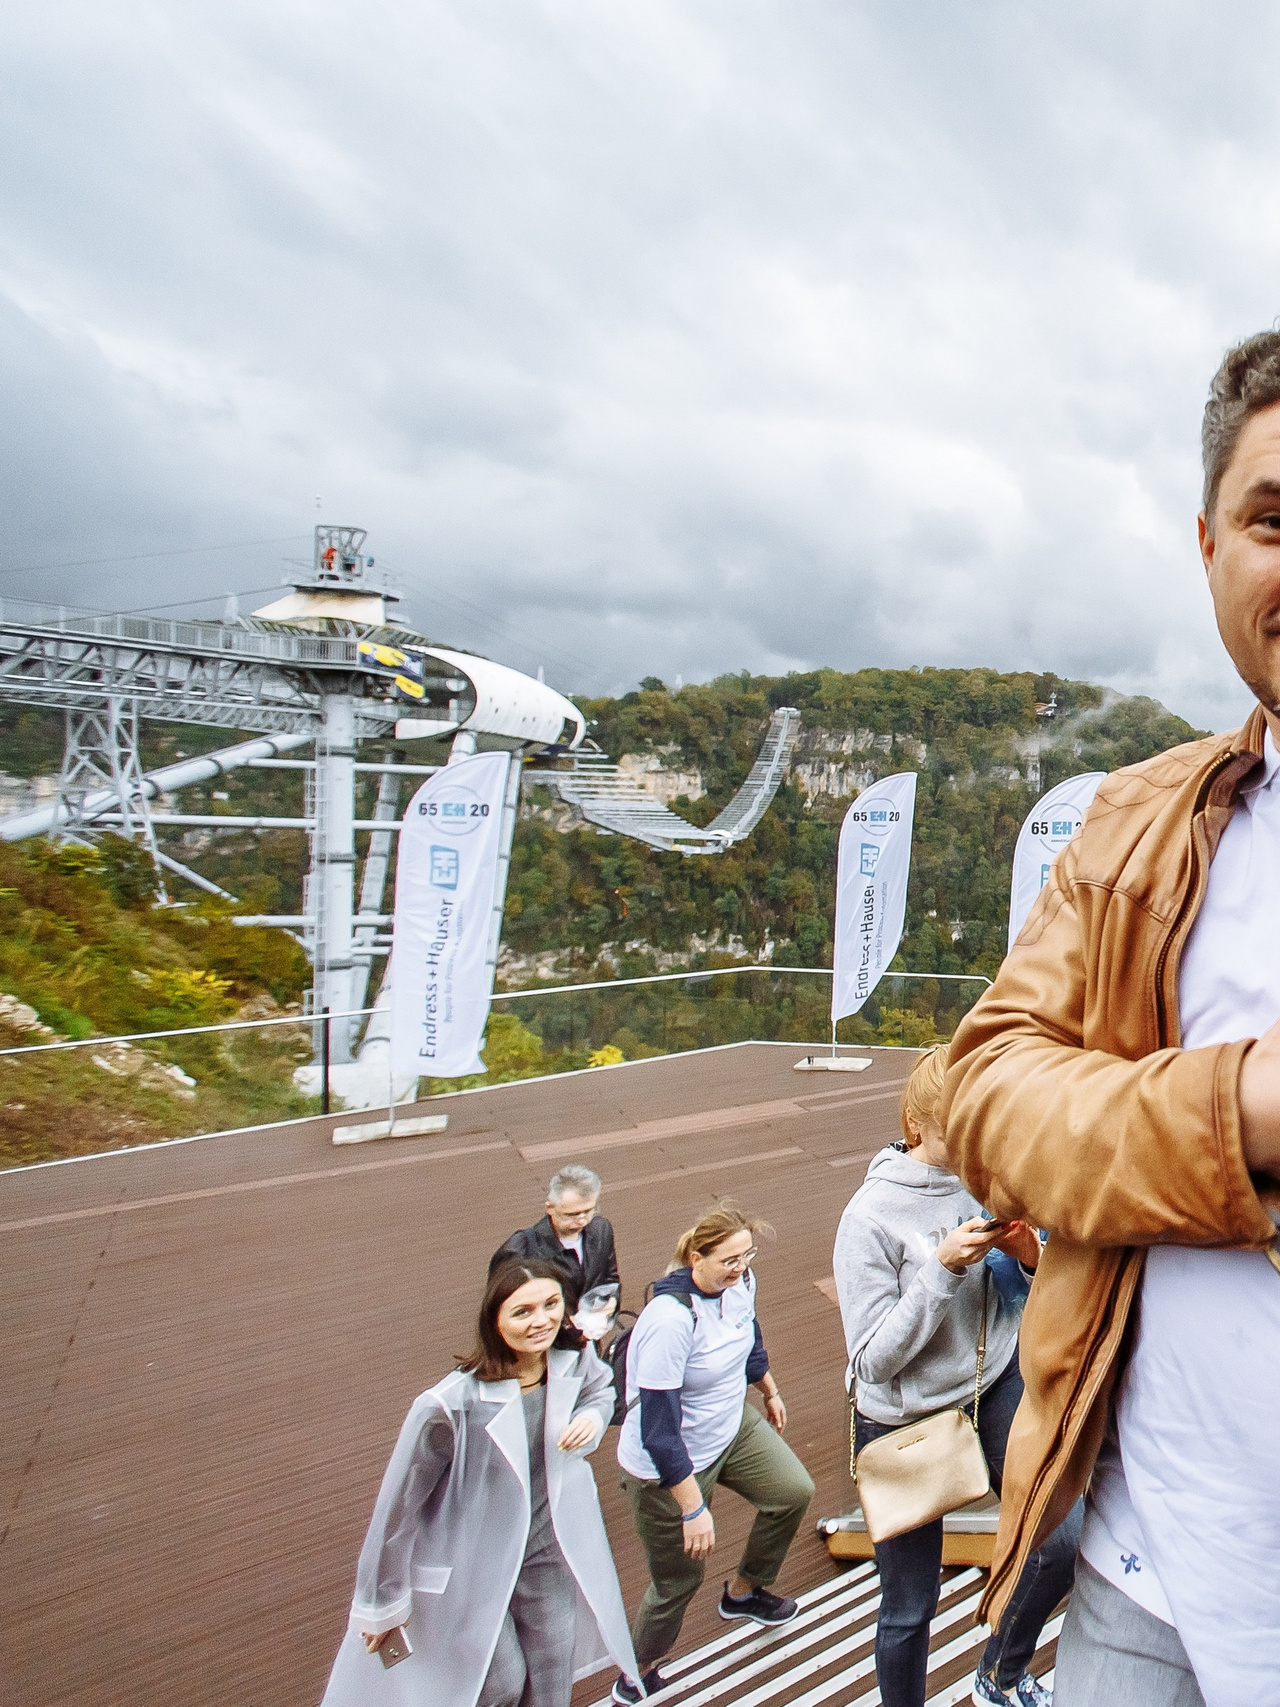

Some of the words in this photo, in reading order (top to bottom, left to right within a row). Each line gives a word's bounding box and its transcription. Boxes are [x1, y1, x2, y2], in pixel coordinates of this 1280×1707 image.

[418, 802, 438, 816] 65
[469, 803, 490, 817] 20
[853, 811, 868, 822] 65
[888, 811, 900, 822] 20
[1031, 821, 1049, 835] 65
